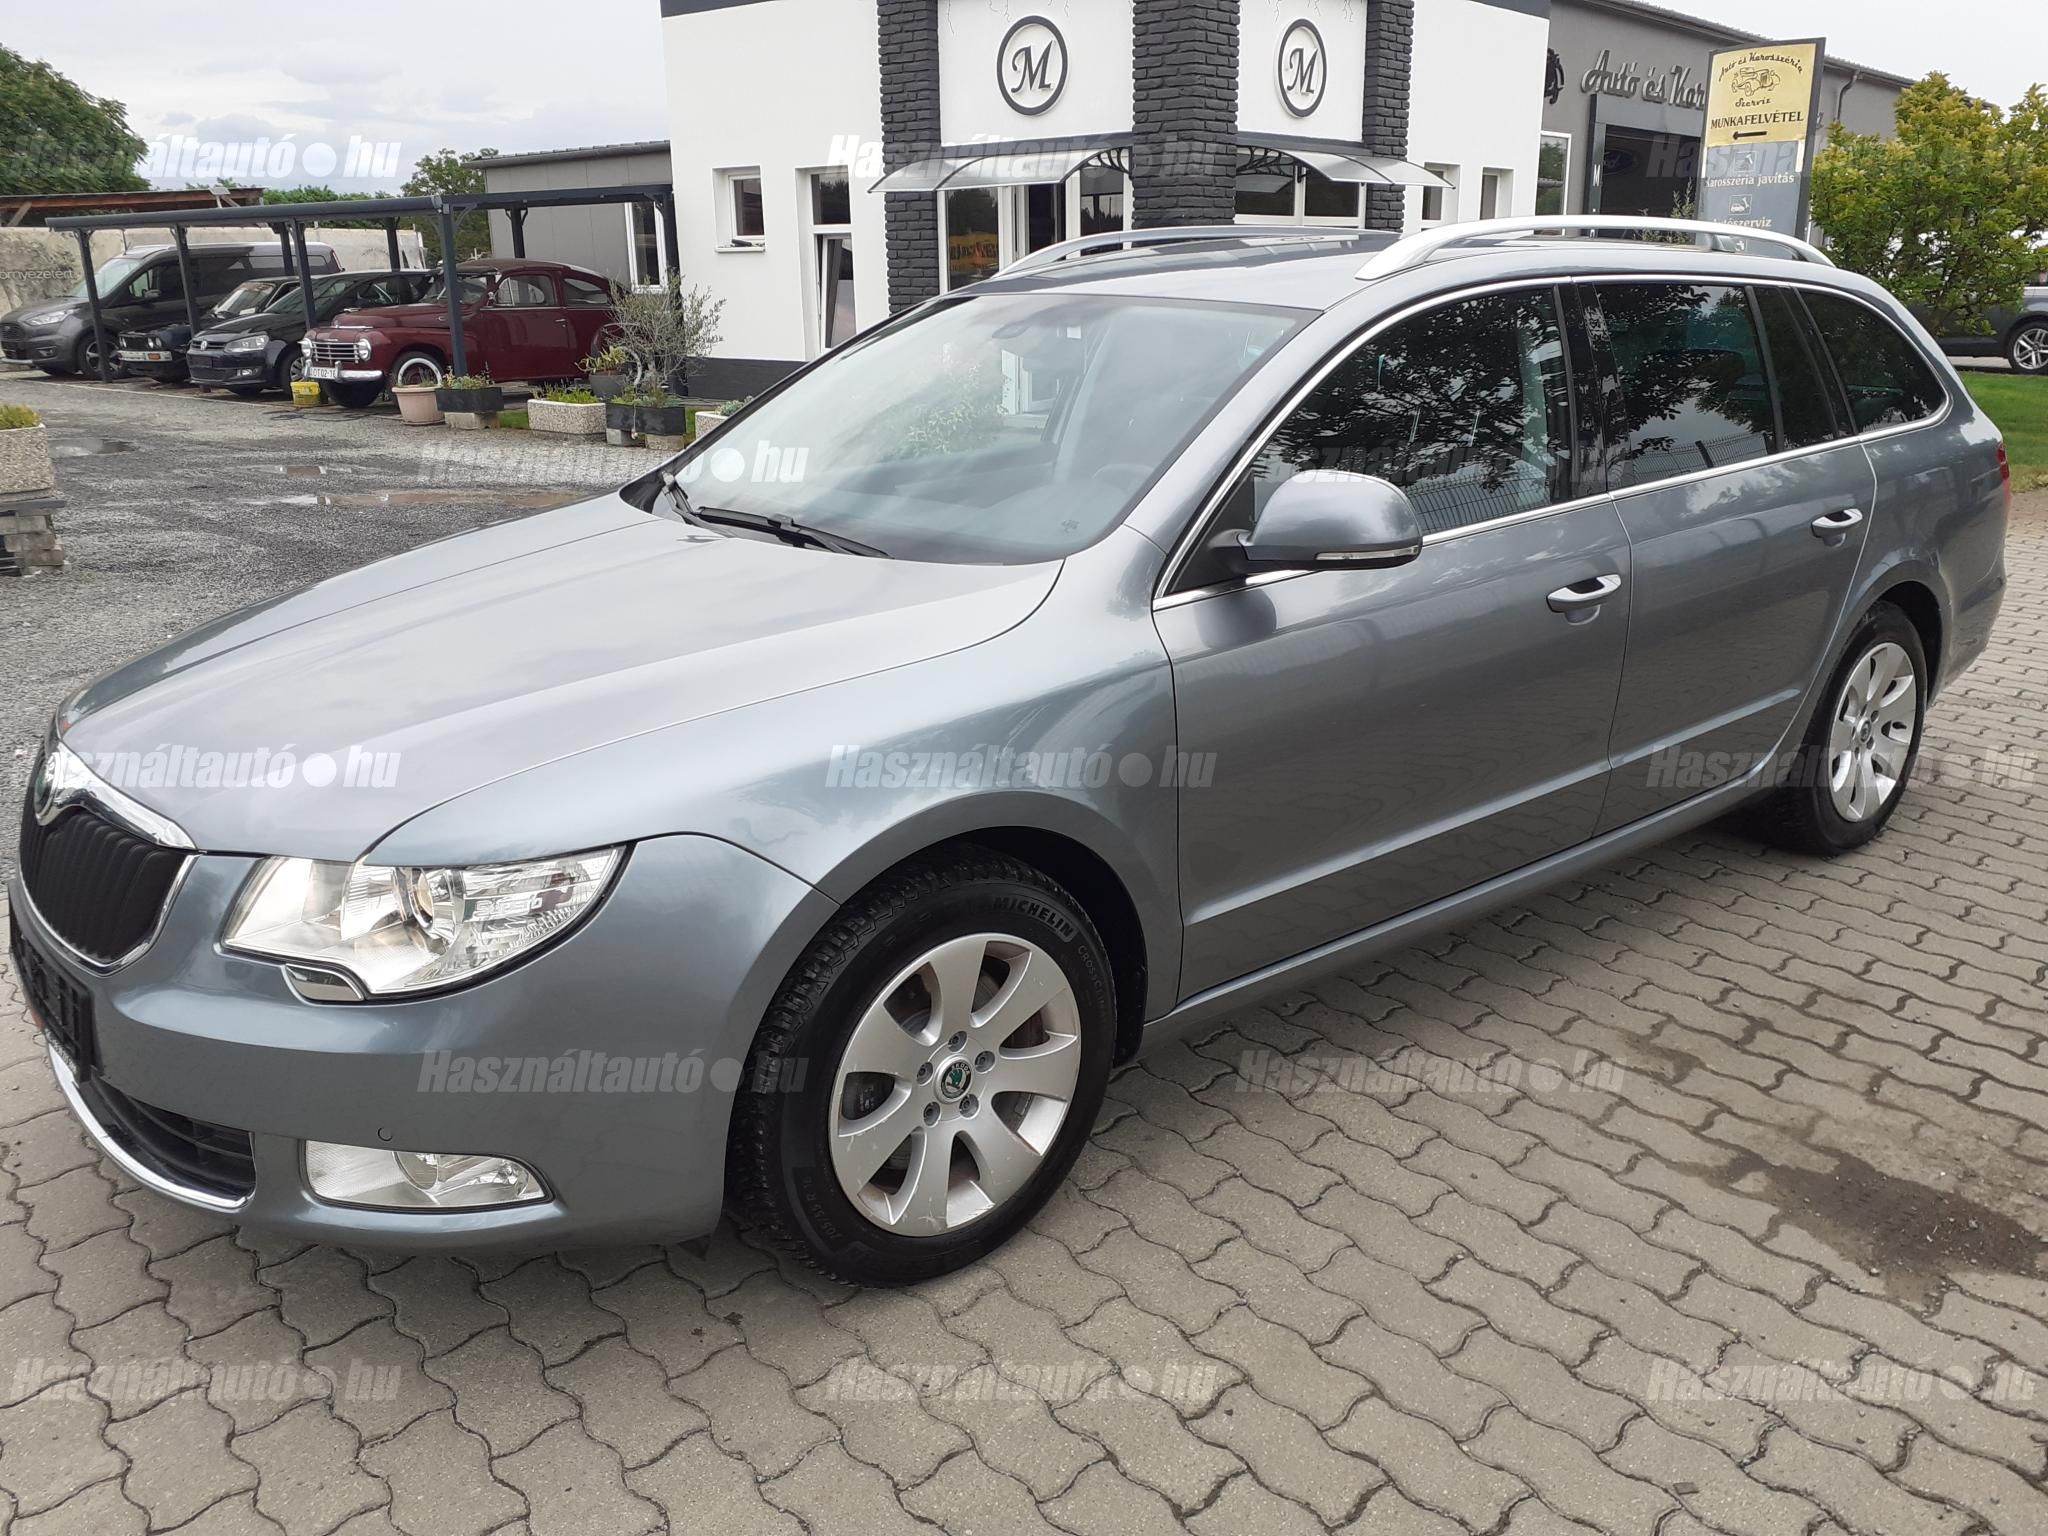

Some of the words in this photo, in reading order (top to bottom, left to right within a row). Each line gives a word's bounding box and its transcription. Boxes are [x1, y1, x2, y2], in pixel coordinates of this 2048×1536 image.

[1011, 40, 1053, 94] M
[1286, 47, 1319, 95] M
[1582, 49, 1640, 97] Autó
[1643, 66, 1668, 103] és
[1710, 110, 1805, 130] MUNKAFELVÉTEL
[1757, 171, 1795, 187] javítás
[992, 896, 1074, 938] MICHELIN
